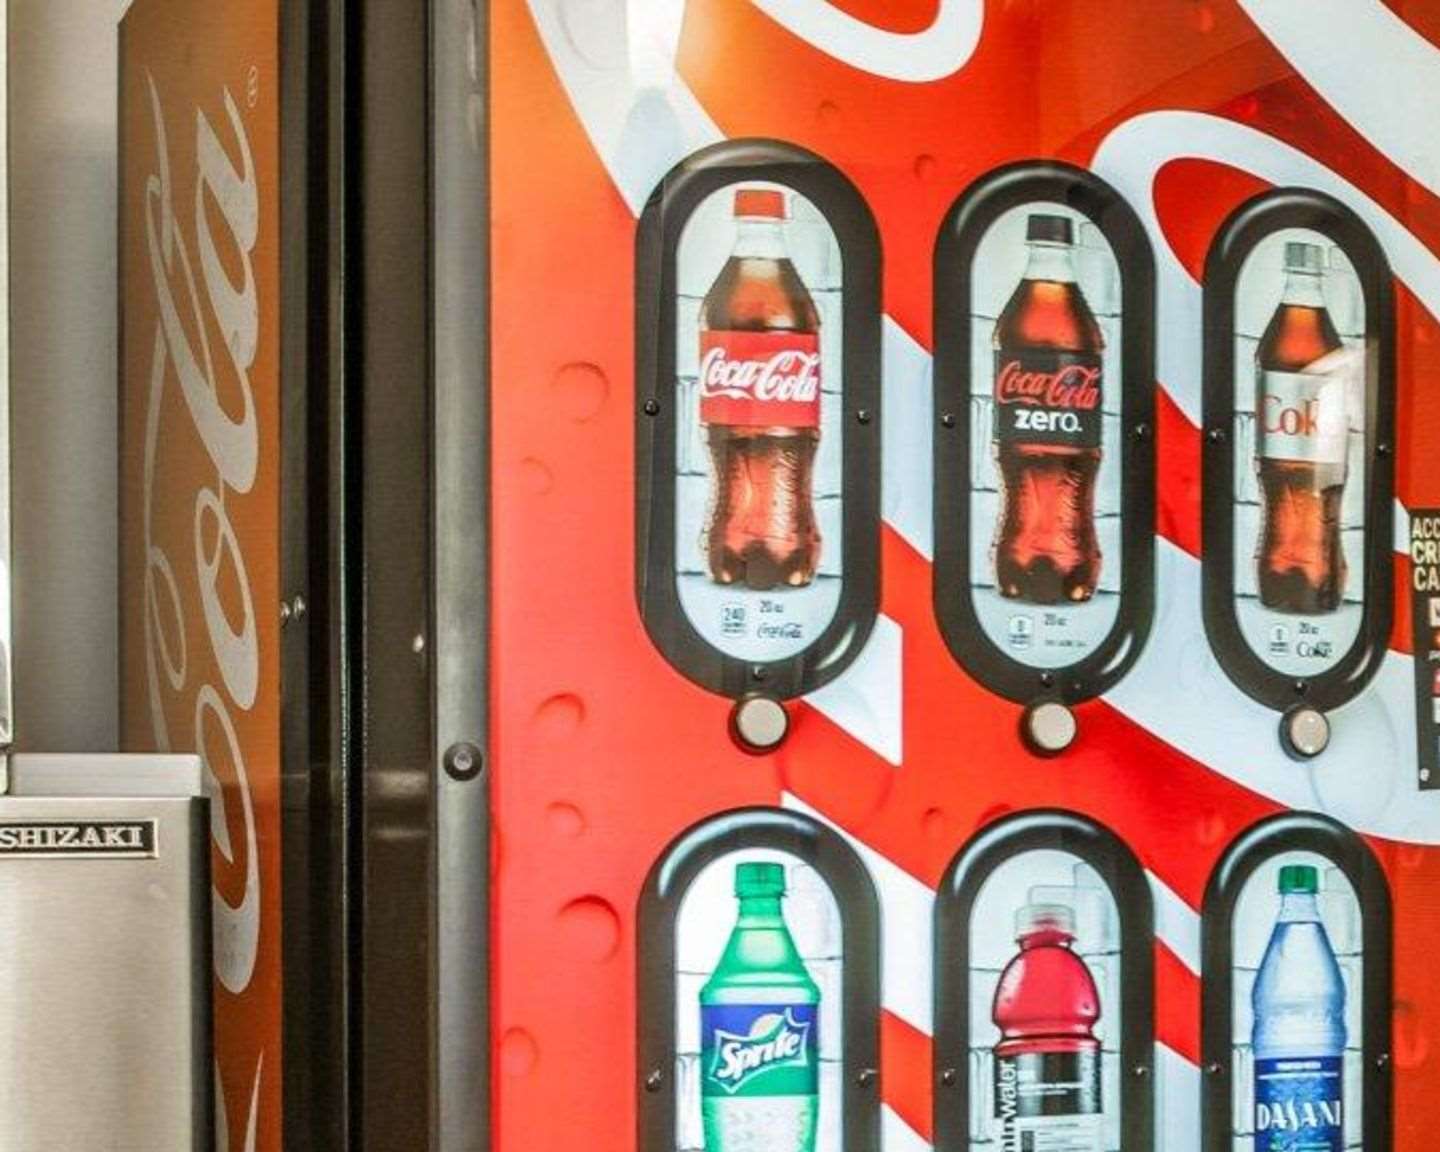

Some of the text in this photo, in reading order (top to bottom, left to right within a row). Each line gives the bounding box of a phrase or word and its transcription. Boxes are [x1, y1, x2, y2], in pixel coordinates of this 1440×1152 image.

[701, 347, 819, 402] Coca-Cola
[996, 360, 1101, 410] Coca-Cola
[0, 826, 144, 848] SHIZAKI
[716, 1026, 801, 1080] Sprite
[1256, 1096, 1341, 1132] DASANI
